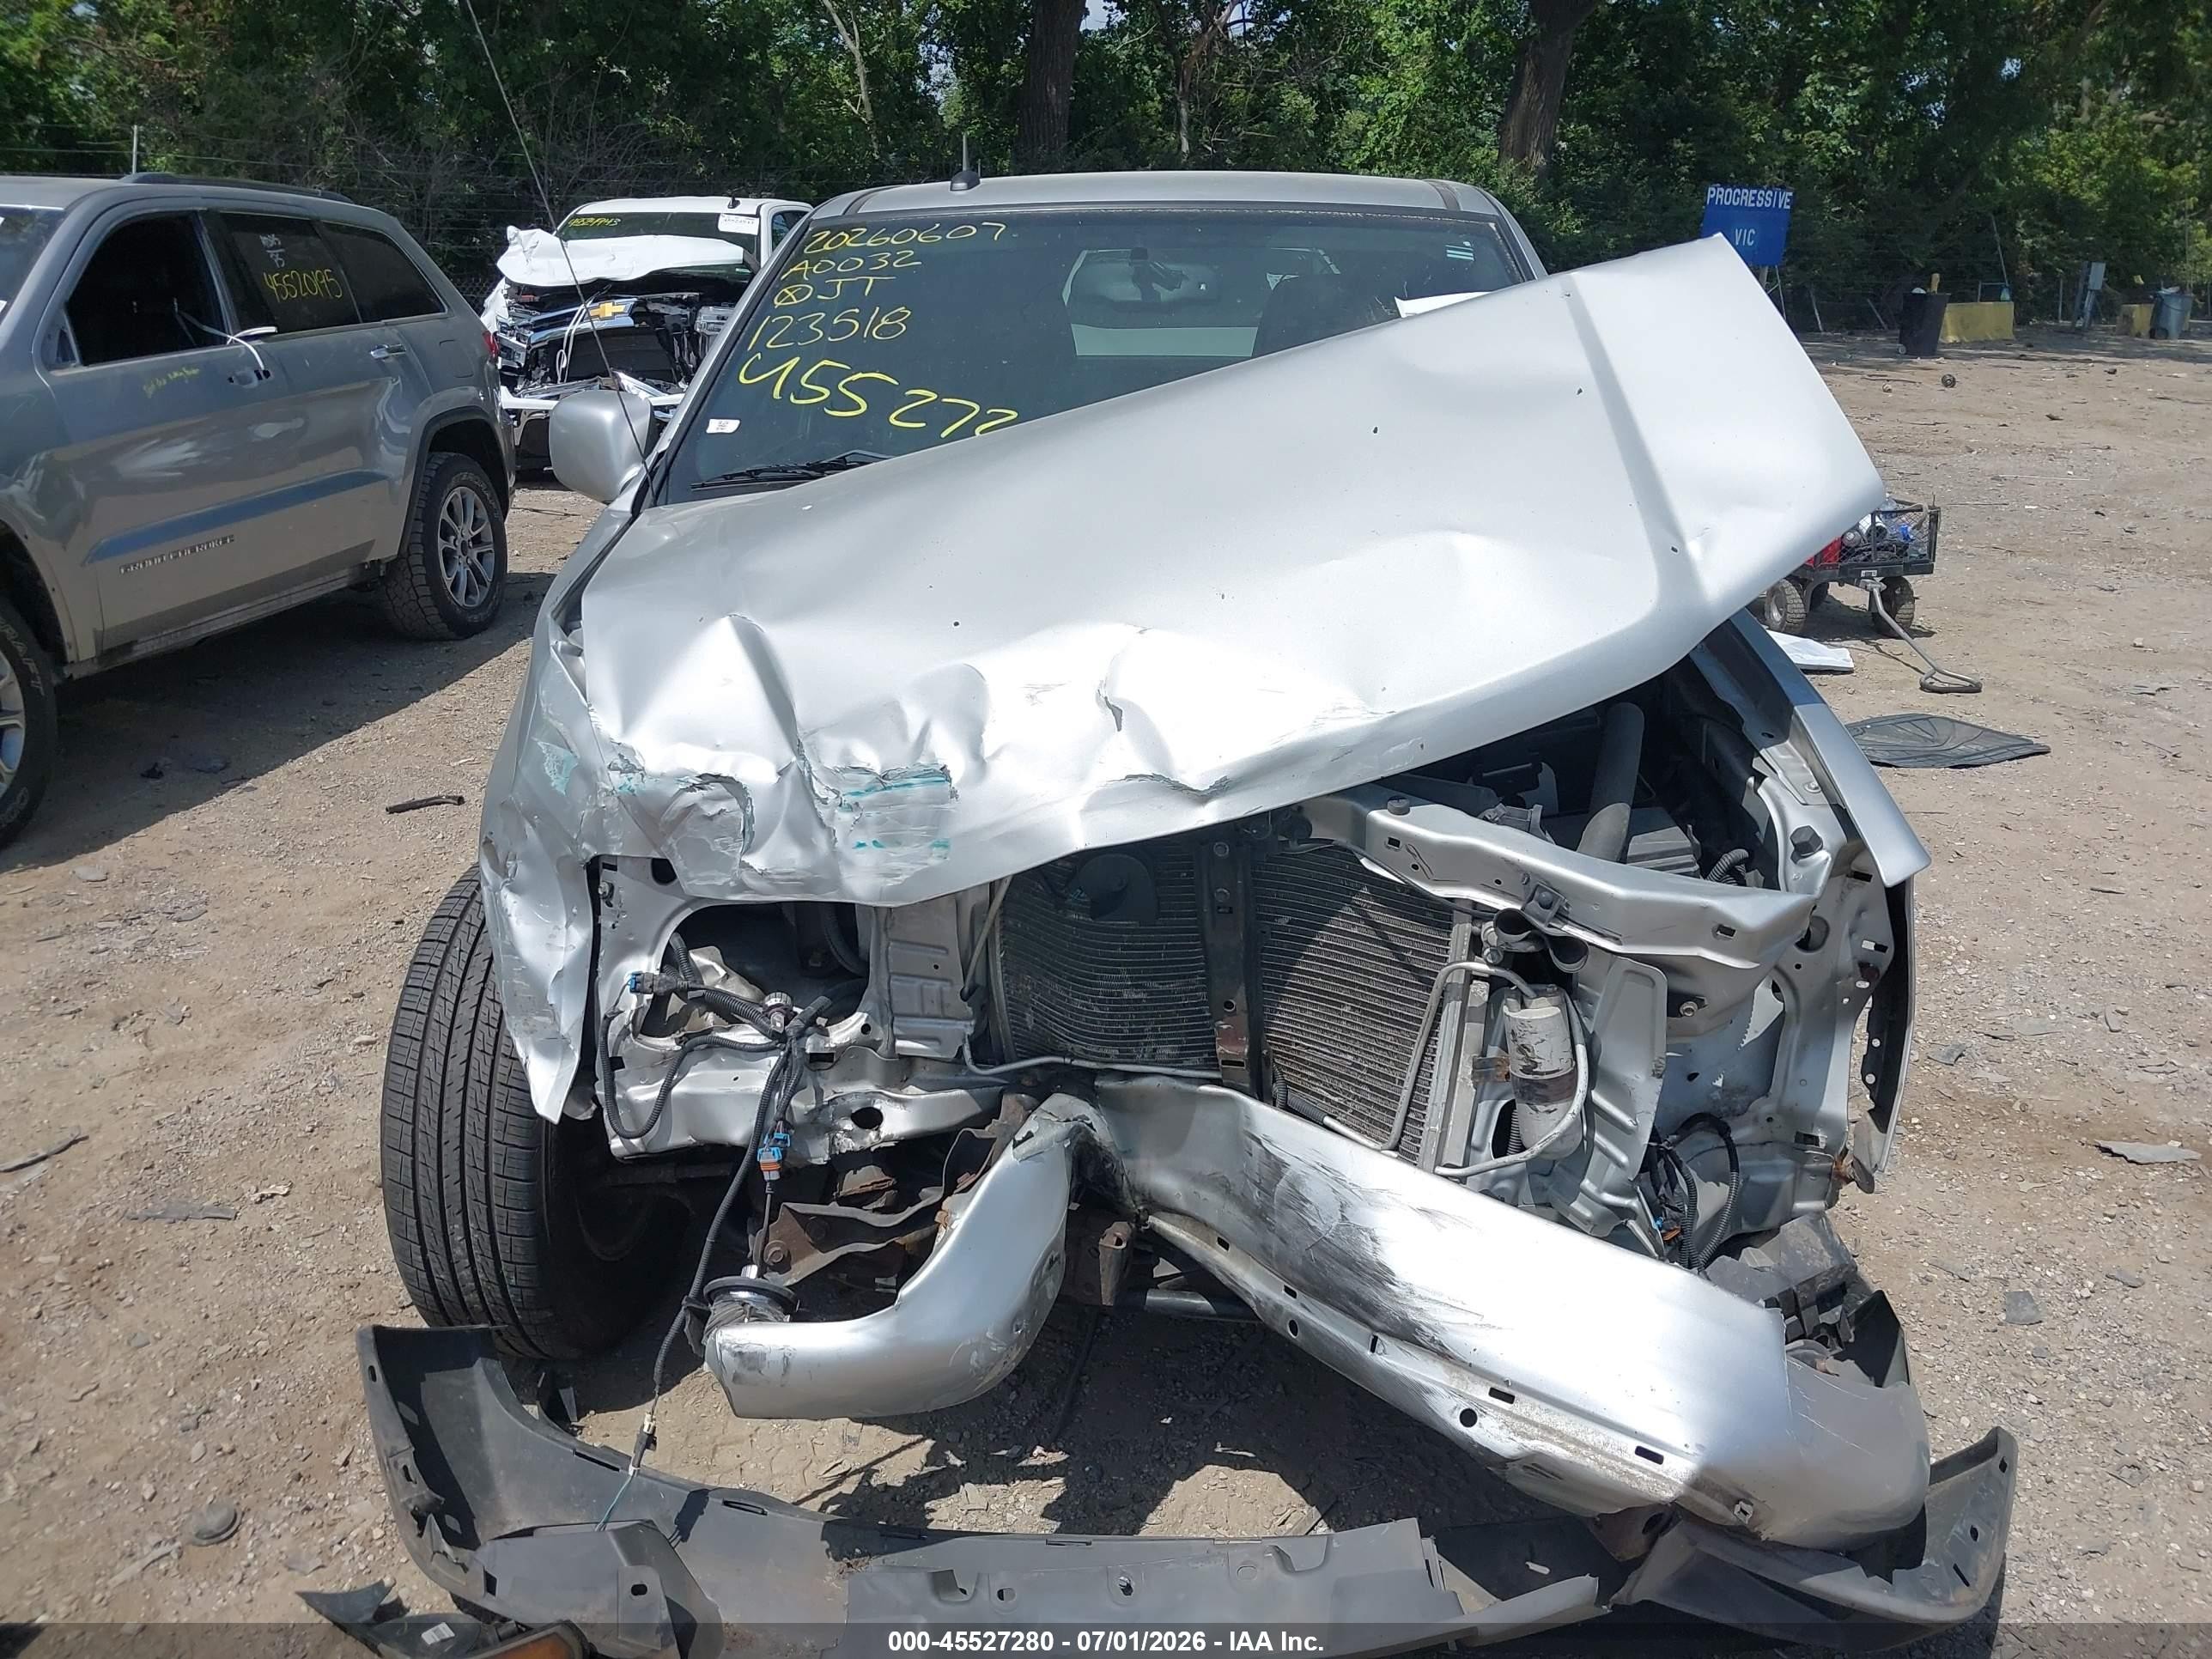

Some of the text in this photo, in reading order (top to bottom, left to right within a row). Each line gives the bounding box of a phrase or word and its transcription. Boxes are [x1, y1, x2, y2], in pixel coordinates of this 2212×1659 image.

[1706, 186, 1793, 210] PROGRESSIVE
[804, 222, 1007, 254] 20260607
[1735, 228, 1756, 247] VIC
[781, 250, 922, 281] A0032
[263, 269, 343, 303] 45520195
[747, 306, 912, 351] 123518
